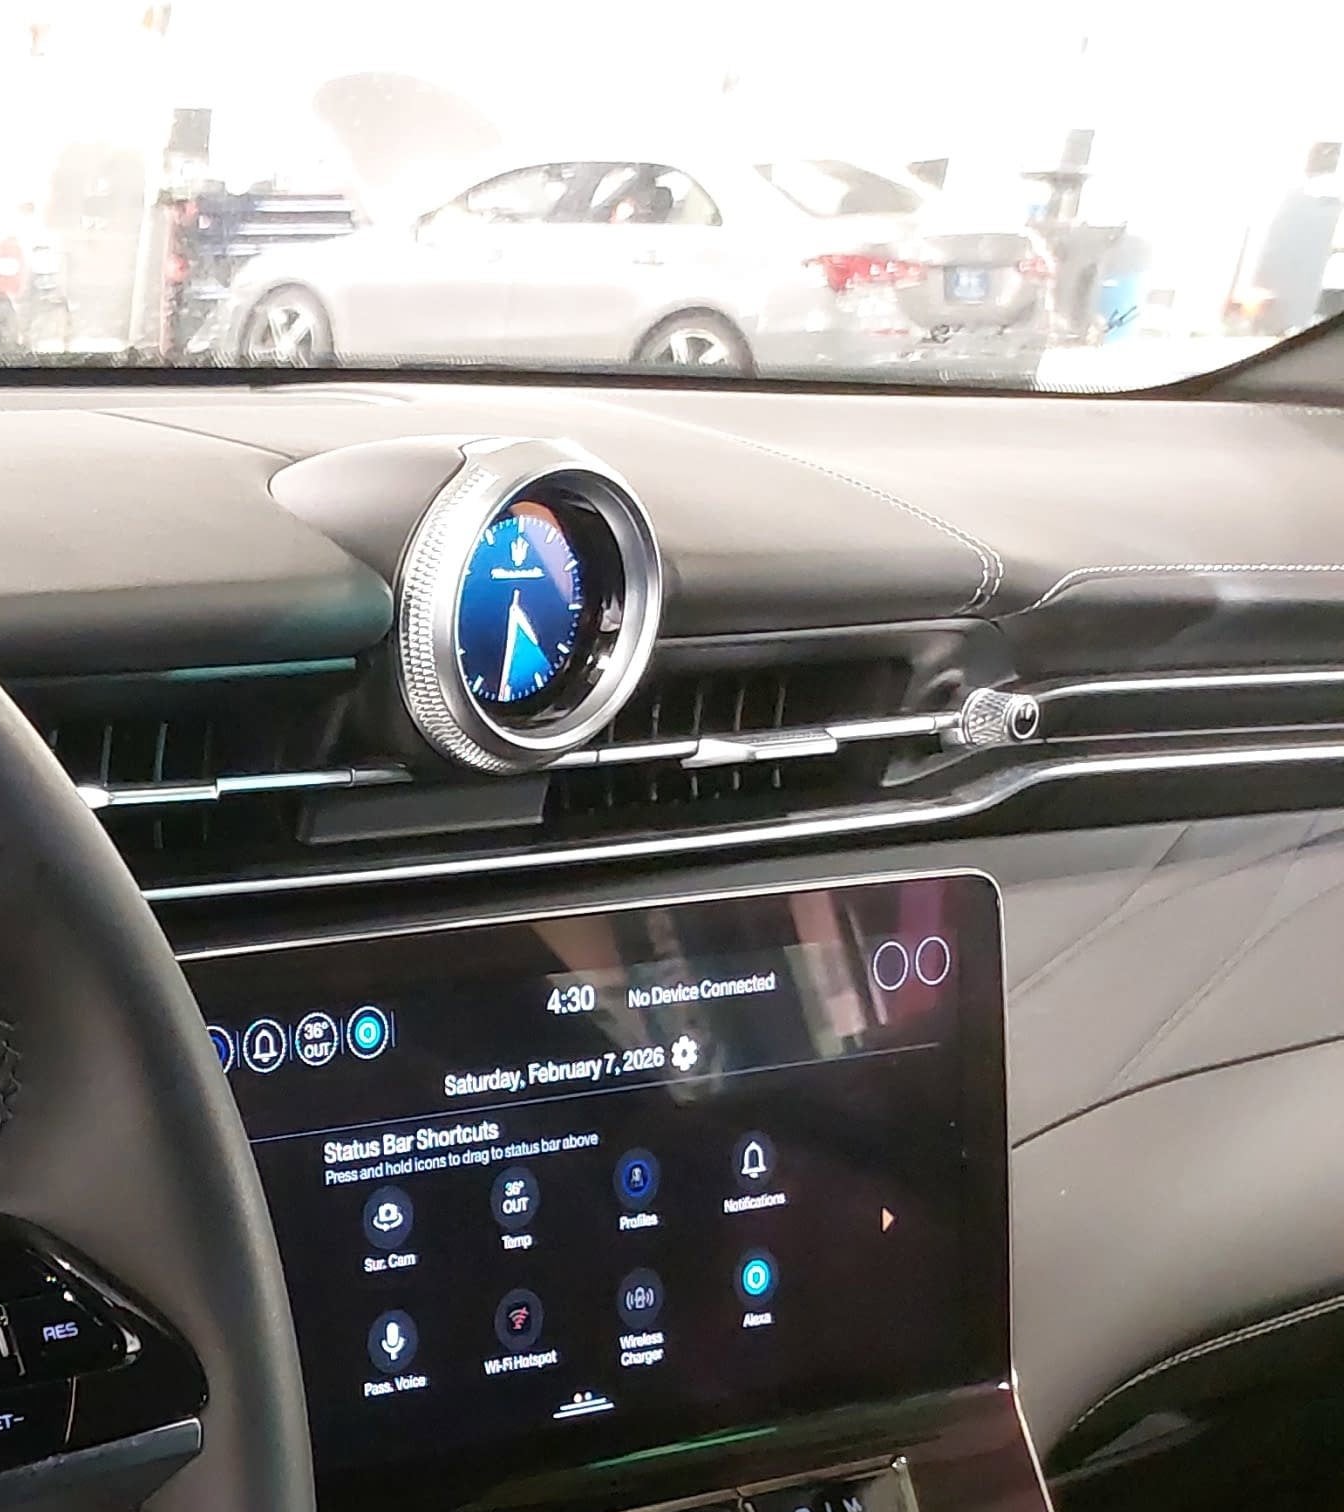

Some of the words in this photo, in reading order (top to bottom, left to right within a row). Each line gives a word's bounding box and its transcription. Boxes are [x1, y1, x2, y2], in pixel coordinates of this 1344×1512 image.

[546, 985, 595, 1014] 4:30
[627, 988, 650, 1008] No
[651, 983, 700, 1005] Device
[700, 971, 776, 998] Connected
[303, 1042, 331, 1060] OUT
[444, 1067, 526, 1097] Saturday,
[527, 1057, 602, 1084] February
[603, 1052, 621, 1076] 7,
[622, 1046, 666, 1072] 2026
[324, 1139, 381, 1165] Status
[382, 1133, 416, 1156] Bar
[416, 1120, 501, 1150] Shortcuts
[325, 1169, 359, 1186] Press
[359, 1162, 384, 1180] and
[385, 1158, 413, 1177] hold
[413, 1156, 448, 1172] icons
[448, 1151, 461, 1167] to
[462, 1146, 490, 1165] drag
[490, 1144, 504, 1160] to
[504, 1139, 540, 1158] status
[540, 1137, 562, 1153] bar
[562, 1132, 600, 1151] above
[502, 1197, 530, 1215] OUT
[723, 1192, 786, 1213] Notifications
[619, 1212, 659, 1230] Profiles
[501, 1233, 532, 1250] Temp
[388, 1252, 417, 1269] Cam
[742, 1312, 773, 1328] Alexa
[43, 1322, 79, 1342] RES
[619, 1330, 664, 1350] Wireless
[513, 1349, 558, 1369] Hotspot
[620, 1348, 664, 1367] Charger
[395, 1373, 427, 1391] Voice
